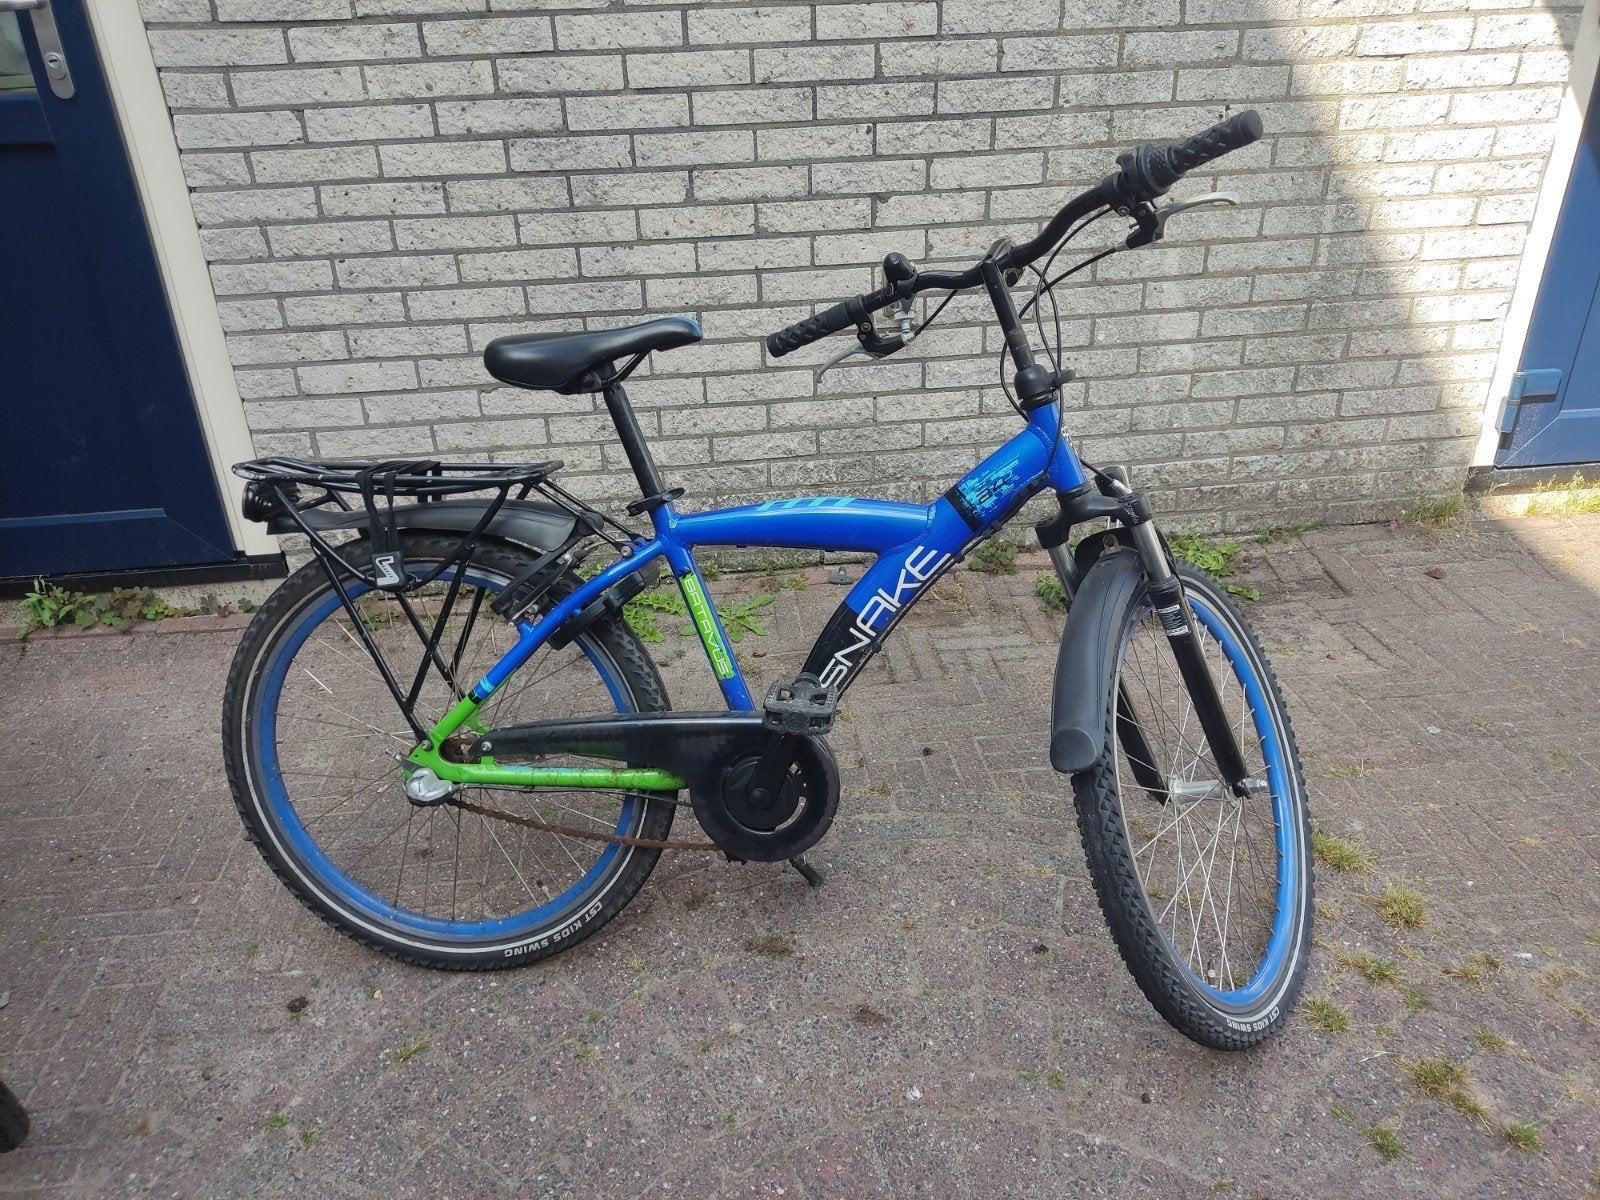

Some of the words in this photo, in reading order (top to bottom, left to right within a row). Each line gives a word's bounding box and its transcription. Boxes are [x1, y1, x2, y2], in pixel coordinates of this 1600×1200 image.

[683, 578, 730, 675] BATAVUS
[819, 545, 951, 689] SNAKE
[584, 901, 603, 923] CST
[553, 920, 582, 943] KIDS
[504, 939, 549, 957] SWING
[1269, 1005, 1280, 1024] CST
[1226, 1018, 1252, 1033] SWING
[1253, 1018, 1269, 1032] KIDS
